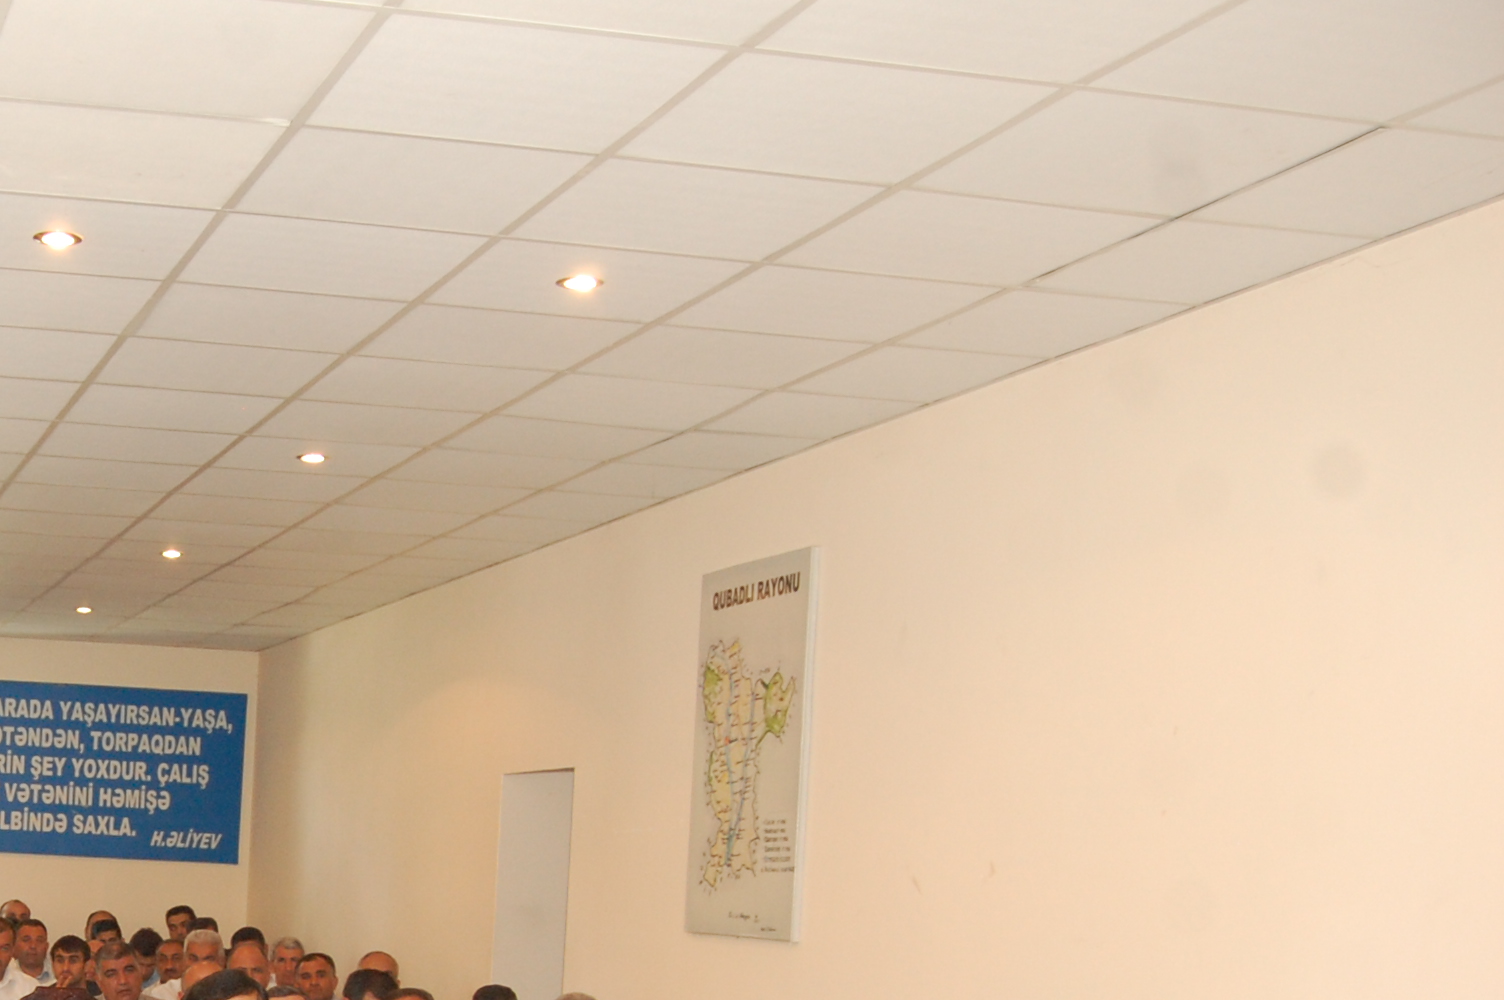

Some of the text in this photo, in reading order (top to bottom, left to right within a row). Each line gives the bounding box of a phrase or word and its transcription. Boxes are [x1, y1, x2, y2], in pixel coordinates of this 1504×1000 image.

[713, 571, 800, 610] QUBADLI RAYONU
[91, 731, 201, 756] TORPAQDAN
[31, 754, 66, 780] ŞEY
[71, 758, 151, 781] YOXDUR.
[157, 762, 209, 788] ÇALIŞ
[5, 782, 93, 806] VƏTƏNİNİ
[99, 785, 171, 814] HƏMİŞƏ
[73, 814, 136, 837] SAXLA.
